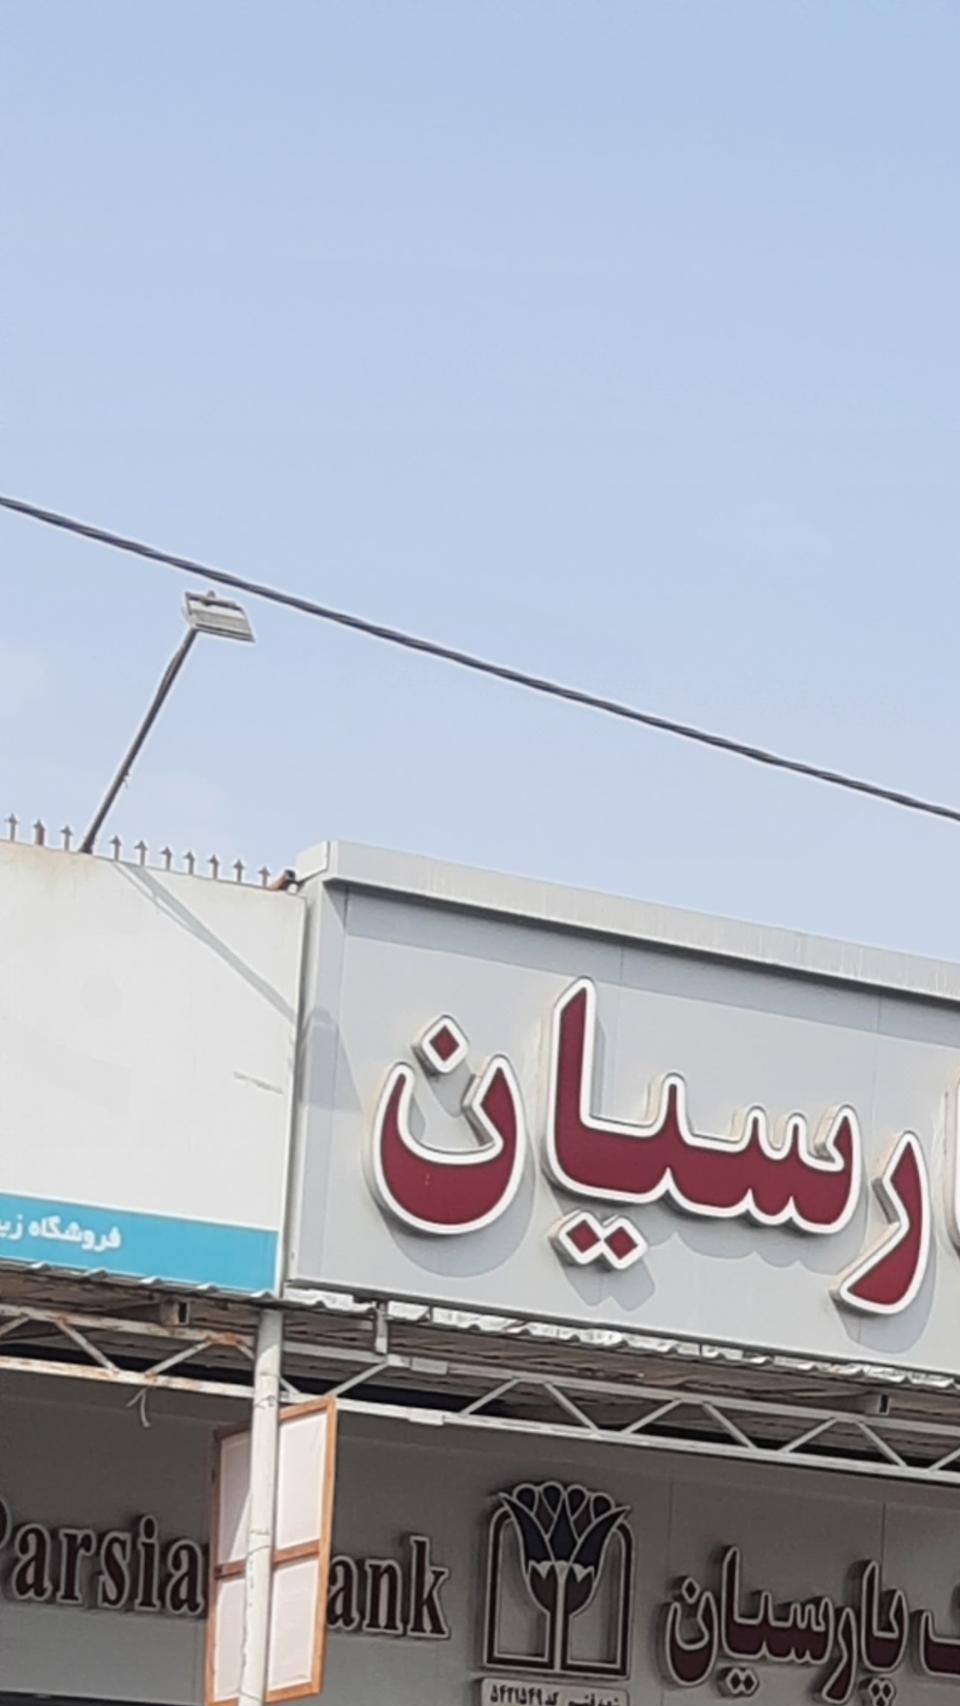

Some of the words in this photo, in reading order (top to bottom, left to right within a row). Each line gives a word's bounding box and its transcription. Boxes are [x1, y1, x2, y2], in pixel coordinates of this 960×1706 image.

[28, 1215, 122, 1252] فروشگاه
[0, 1492, 209, 1616] arsia
[326, 1533, 450, 1640] ank
